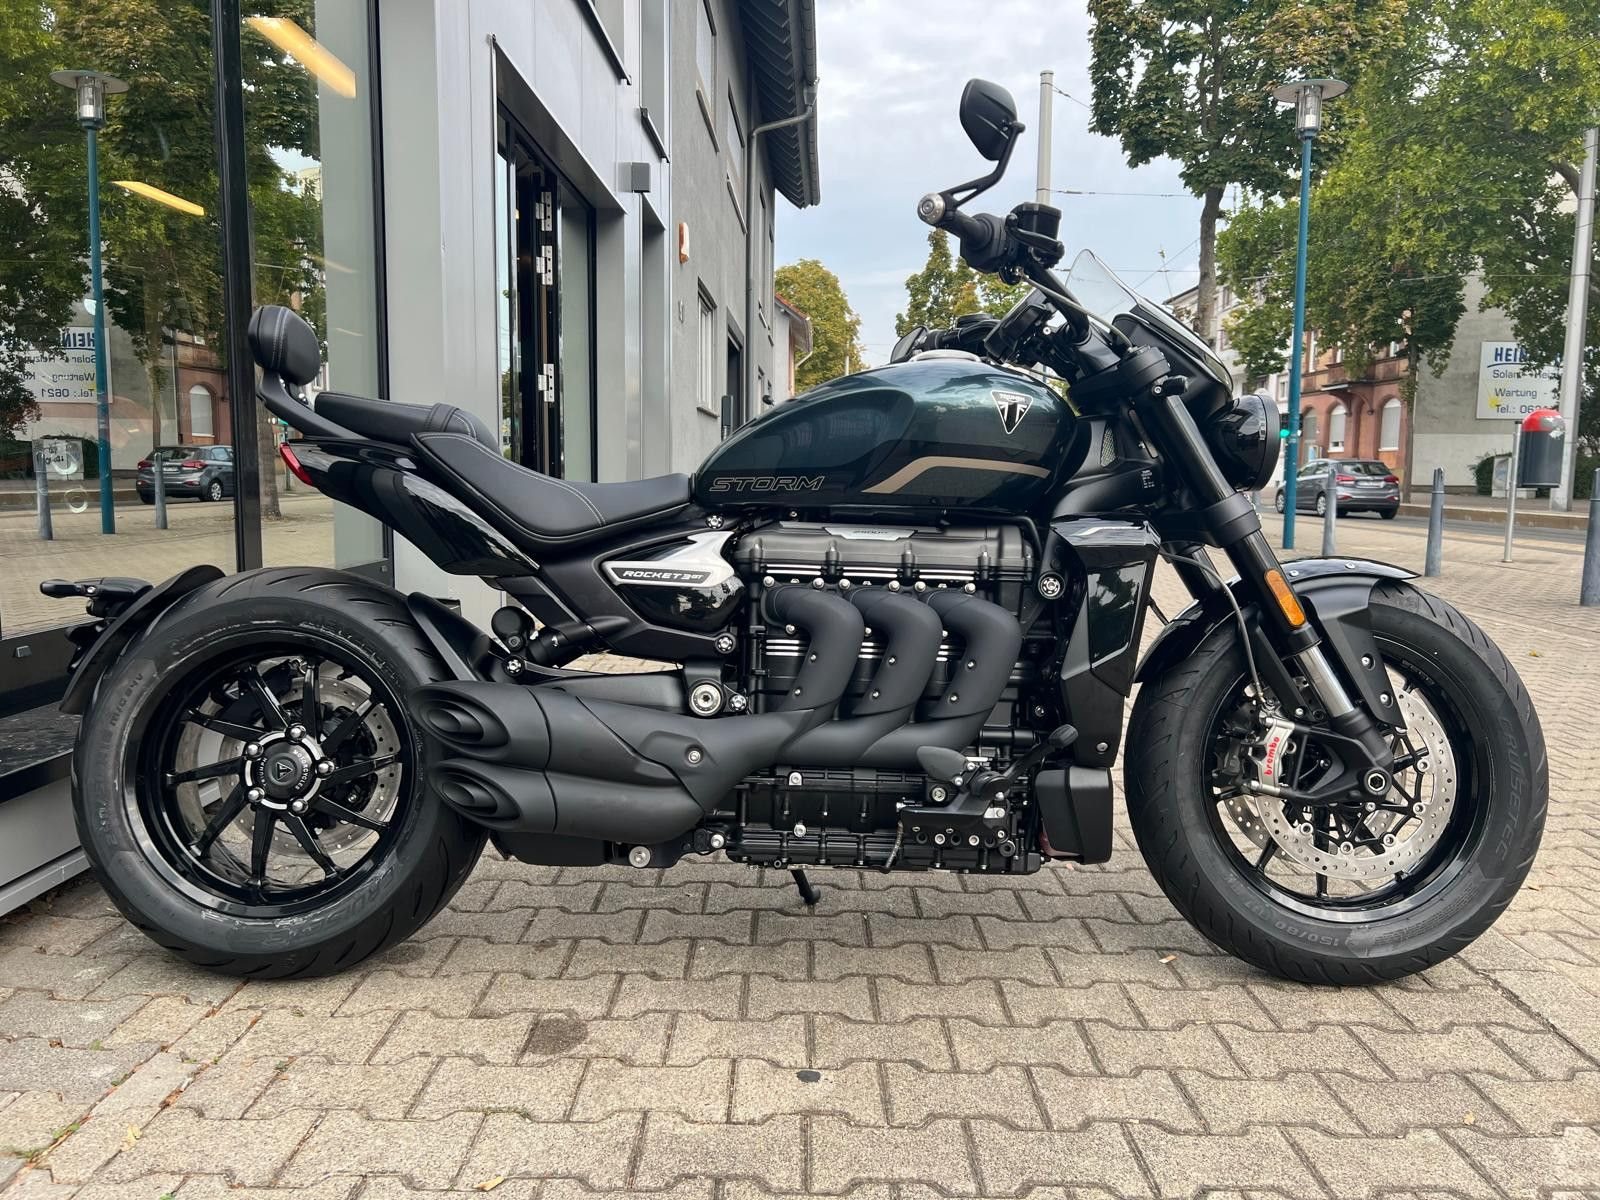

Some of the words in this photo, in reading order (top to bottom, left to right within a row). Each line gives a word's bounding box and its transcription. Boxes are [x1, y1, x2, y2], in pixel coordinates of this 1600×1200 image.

[1495, 388, 1537, 399] Wartung
[1495, 404, 1516, 414] Tel.:
[709, 476, 825, 492] STORM
[1264, 736, 1280, 776] brembo
[1274, 920, 1339, 947] 150/80
